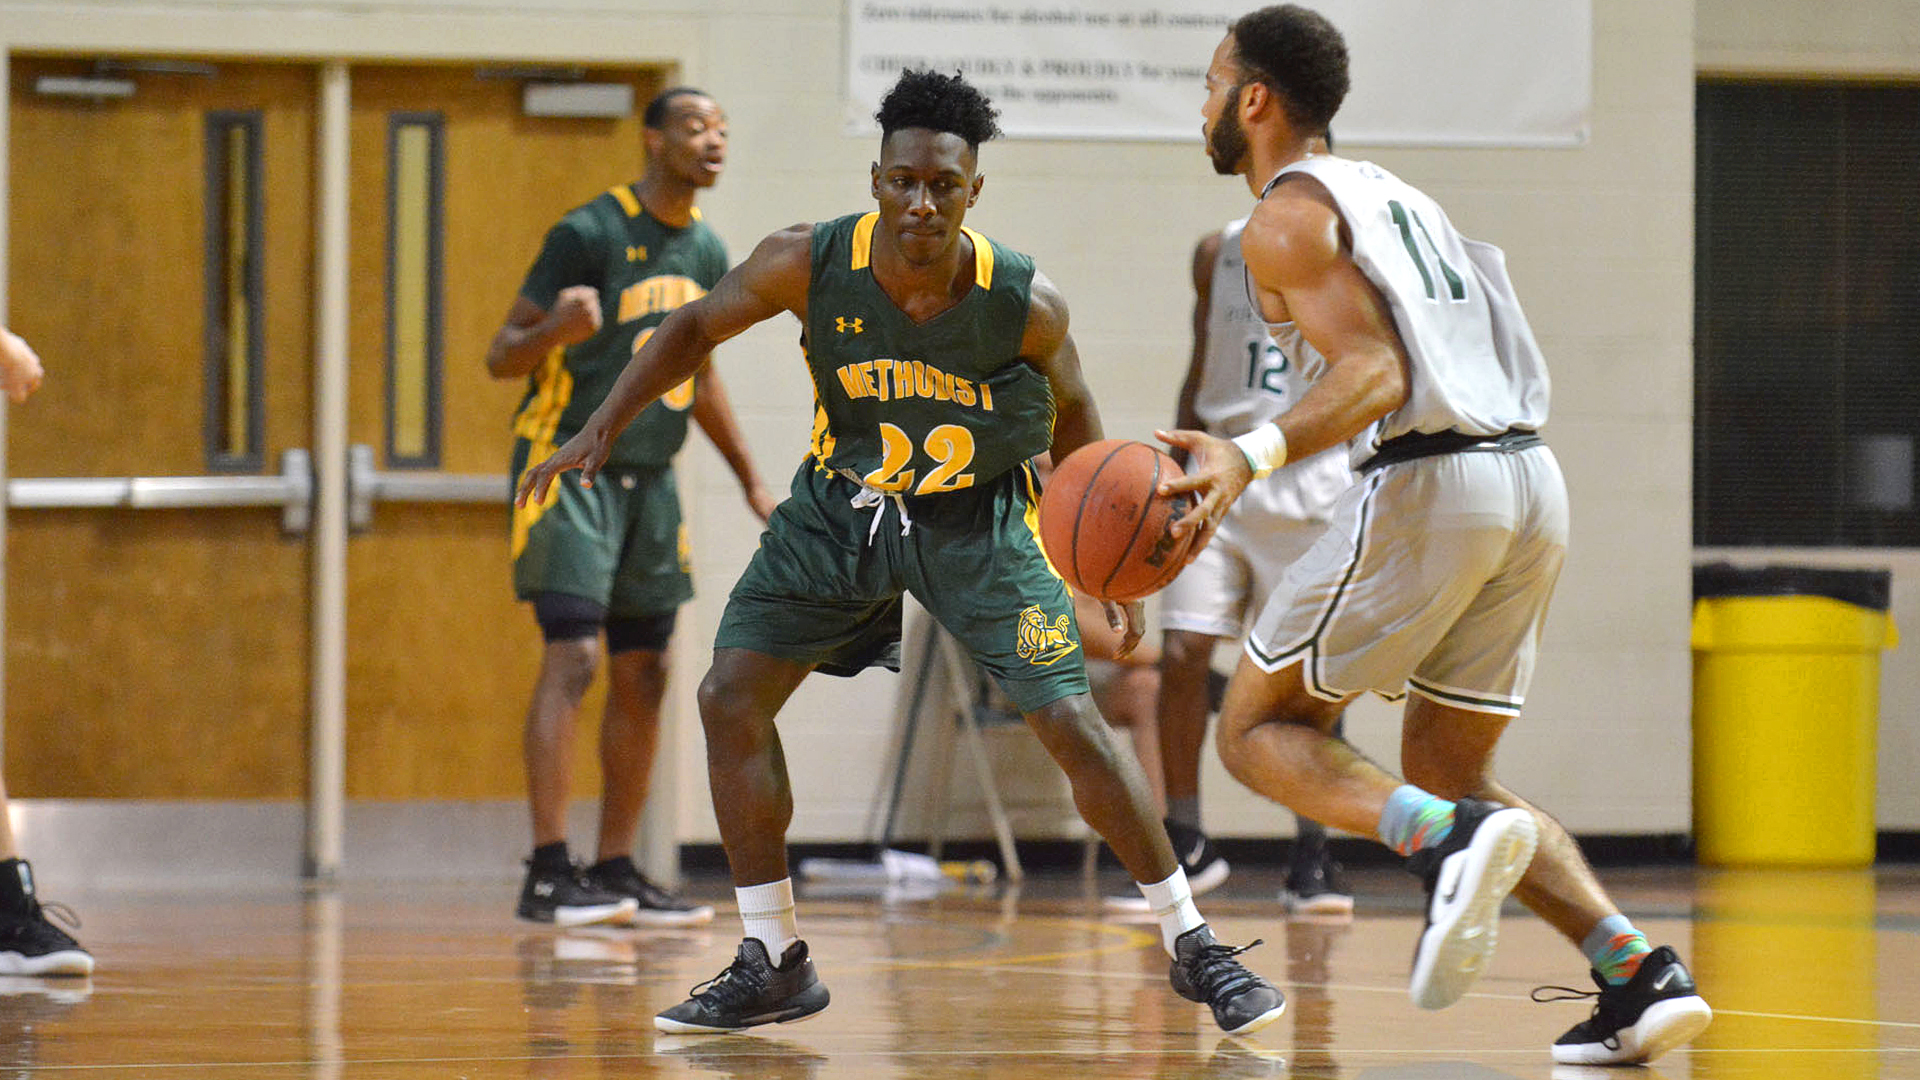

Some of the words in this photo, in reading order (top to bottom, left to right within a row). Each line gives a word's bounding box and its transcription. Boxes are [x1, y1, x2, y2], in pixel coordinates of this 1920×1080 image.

[1387, 199, 1468, 305] 11
[1247, 340, 1288, 395] 12
[862, 422, 976, 496] 22
